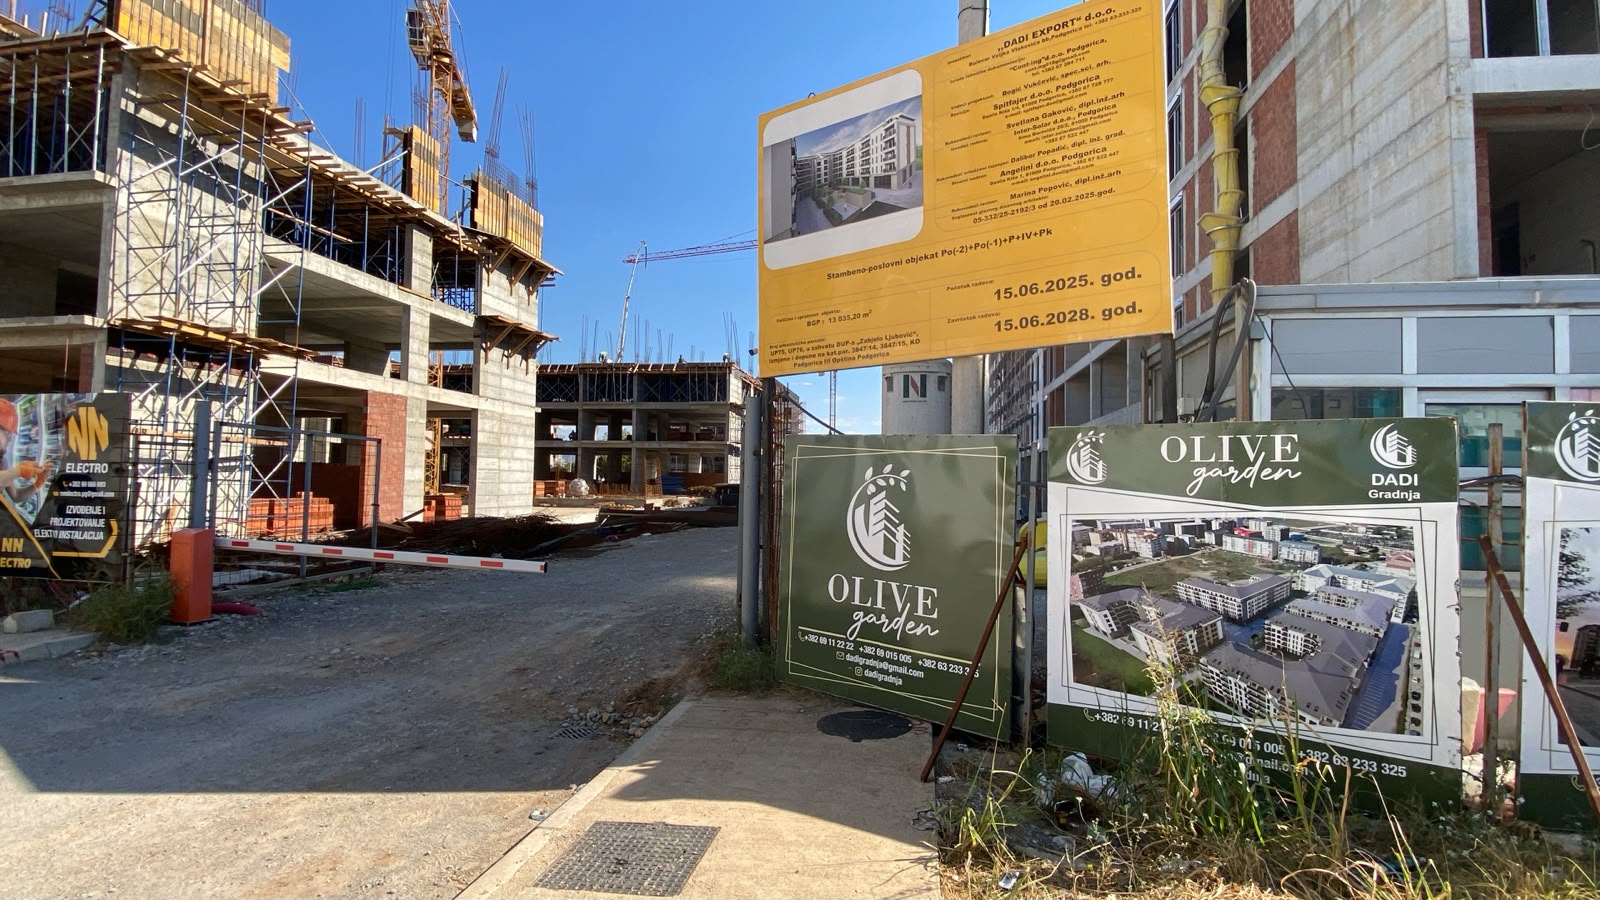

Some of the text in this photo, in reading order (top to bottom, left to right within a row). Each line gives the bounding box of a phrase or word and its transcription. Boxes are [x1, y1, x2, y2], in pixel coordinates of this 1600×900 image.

[1084, 7, 1115, 21] d.o.o.
[1066, 38, 1107, 54] Podgorica,
[1002, 86, 1021, 96] Bogić
[1096, 59, 1111, 67] arh.
[993, 96, 1028, 110] Spitfajer
[1029, 89, 1052, 99] d.o.o.
[1055, 74, 1100, 92] Podgorica
[1006, 116, 1039, 129] Svetlana
[1041, 105, 1076, 118] Gaković,
[1013, 121, 1051, 135] Inter-Solar
[1052, 116, 1075, 124] d.o.o.,
[1077, 103, 1116, 118] Podgorica
[1010, 152, 1035, 163] Dalibor
[1037, 144, 1069, 156] Popadić,
[1070, 139, 1087, 147] dipl.
[1105, 129, 1125, 140] grad.
[999, 163, 1033, 177] Angelini
[1035, 158, 1059, 168] d.o.o.
[1061, 146, 1106, 161] Podgorica
[1009, 190, 1035, 199] Marina
[1038, 181, 1072, 193] Popović,
[972, 204, 1035, 223] 05-332/25-2192/3
[1049, 187, 1115, 206] 20.02.2025.god.
[826, 228, 1052, 279] Stambeno-poslovni objekat Po(-2)+Po(-1)+P+IV+Pk
[993, 266, 1142, 300] 15.06.2025. god.
[838, 312, 860, 322] 035,20
[993, 301, 1143, 331] 15.06.2028. god.
[857, 351, 889, 360] Podgorica
[1160, 434, 1299, 464] OLIVE
[66, 463, 108, 474] ELECTRO
[1186, 452, 1302, 496] garden
[1372, 473, 1418, 486] DADI
[1368, 489, 1420, 501] Gradnja
[50, 517, 106, 528] PROJEKTOVANJE
[2, 537, 24, 552] NN
[59, 530, 104, 540] INSTALACIJA
[0, 557, 32, 568] ECTRO
[828, 574, 938, 618] OLIVE
[846, 602, 939, 640] garden
[804, 634, 818, 643] +382
[819, 637, 827, 645] 69
[837, 640, 845, 648] 22
[846, 642, 854, 650] 22
[859, 645, 912, 663] +382 69 015 005
[846, 653, 924, 678] dadigradnja@gmail.com
[918, 658, 979, 678] +382 63 233 35
[864, 669, 902, 685] dadigradnja
[1094, 712, 1119, 724] +382
[1137, 719, 1148, 730] 11
[1298, 749, 1329, 763] +382
[1333, 755, 1348, 767] 63
[1353, 758, 1377, 772] 233
[1381, 763, 1406, 777] 325
